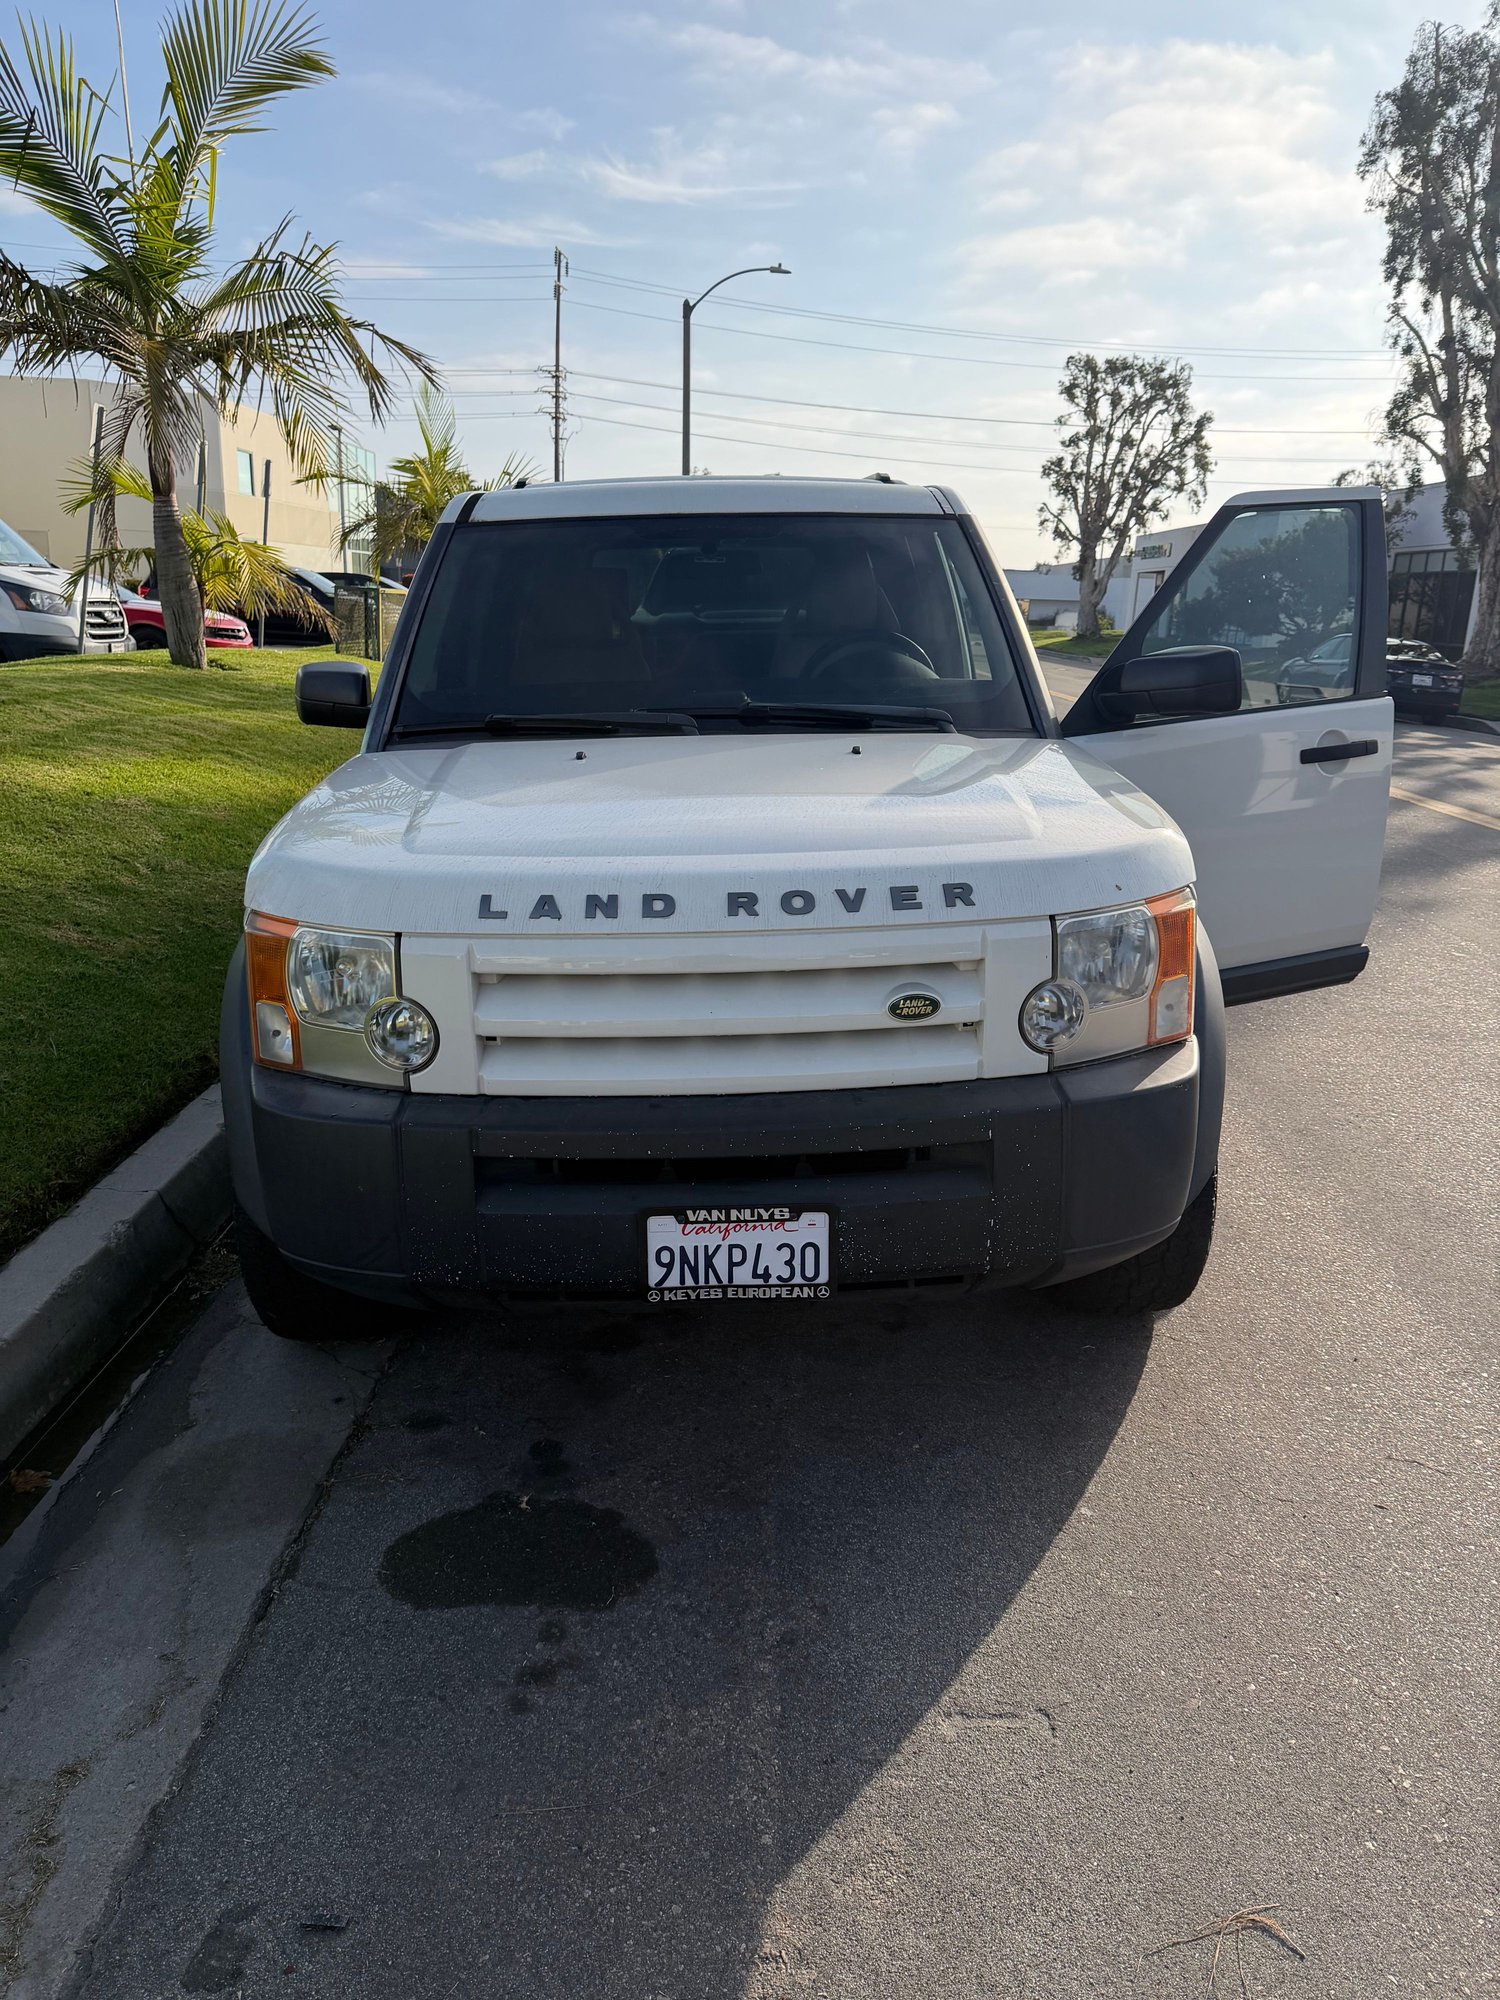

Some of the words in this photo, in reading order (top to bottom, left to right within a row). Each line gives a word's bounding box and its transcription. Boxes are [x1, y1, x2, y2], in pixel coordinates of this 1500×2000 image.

[478, 894, 676, 920] LAND
[727, 882, 976, 917] ROVER
[686, 1209, 726, 1222] VAN
[730, 1208, 790, 1221] NUYS
[682, 1221, 799, 1241] California
[654, 1242, 820, 1287] 9NKP430
[664, 1288, 723, 1301] KEYES
[727, 1287, 814, 1299] EUROPEAN
